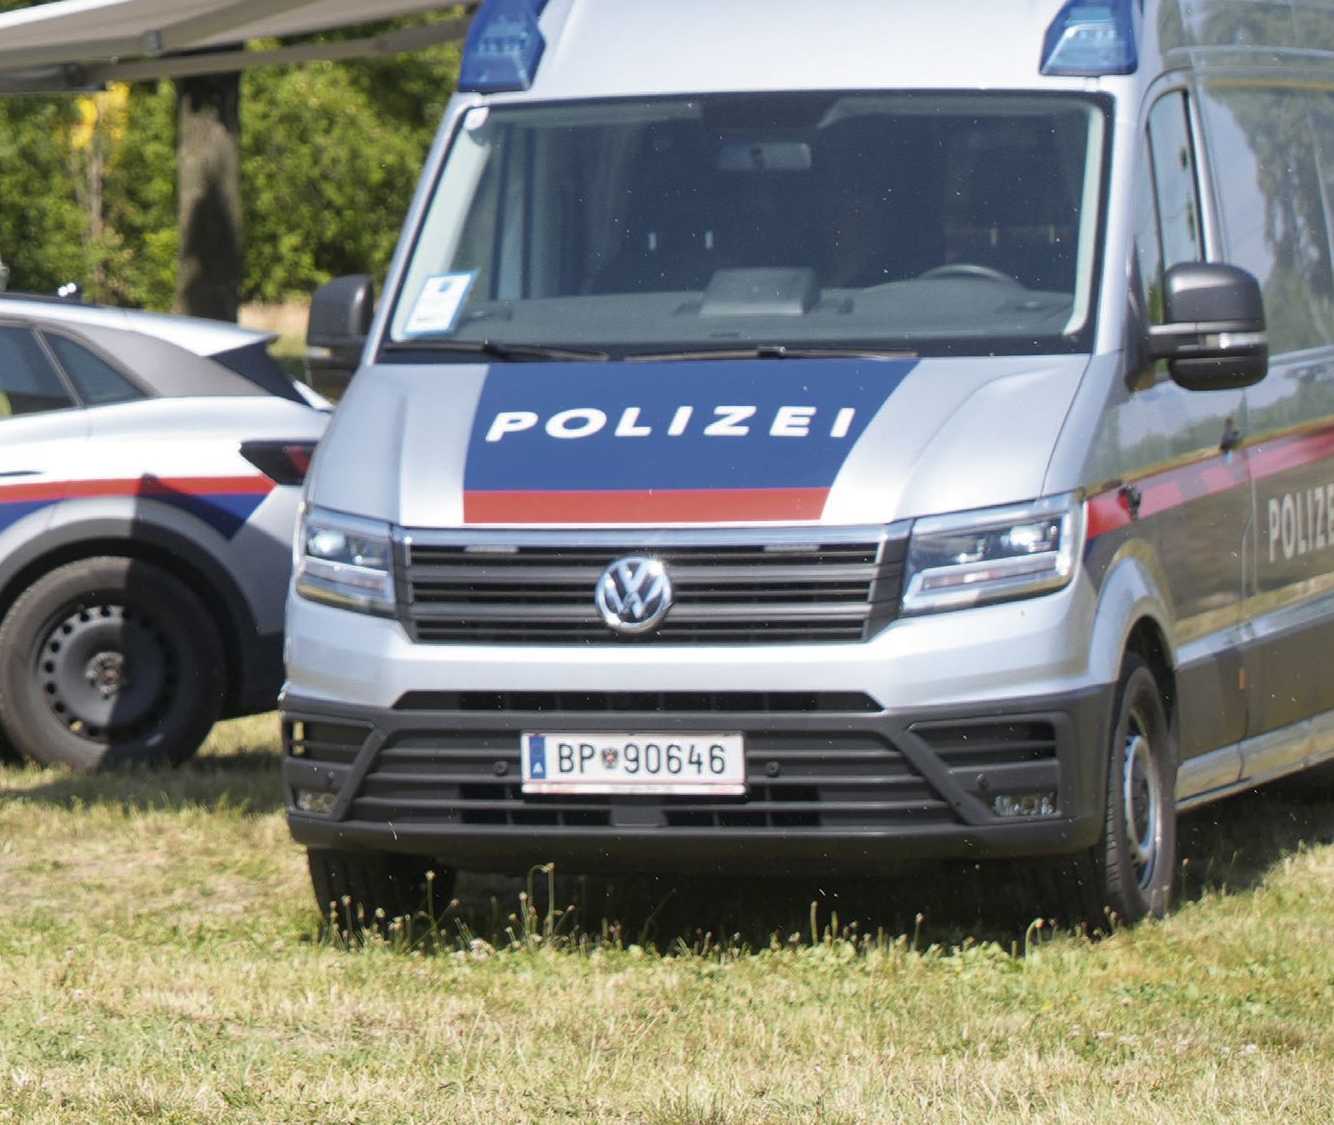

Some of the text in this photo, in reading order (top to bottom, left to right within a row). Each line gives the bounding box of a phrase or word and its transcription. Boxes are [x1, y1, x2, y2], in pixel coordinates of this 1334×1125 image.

[484, 405, 856, 443] POLIZEI
[558, 743, 595, 774] BP
[623, 743, 726, 775] 90646
